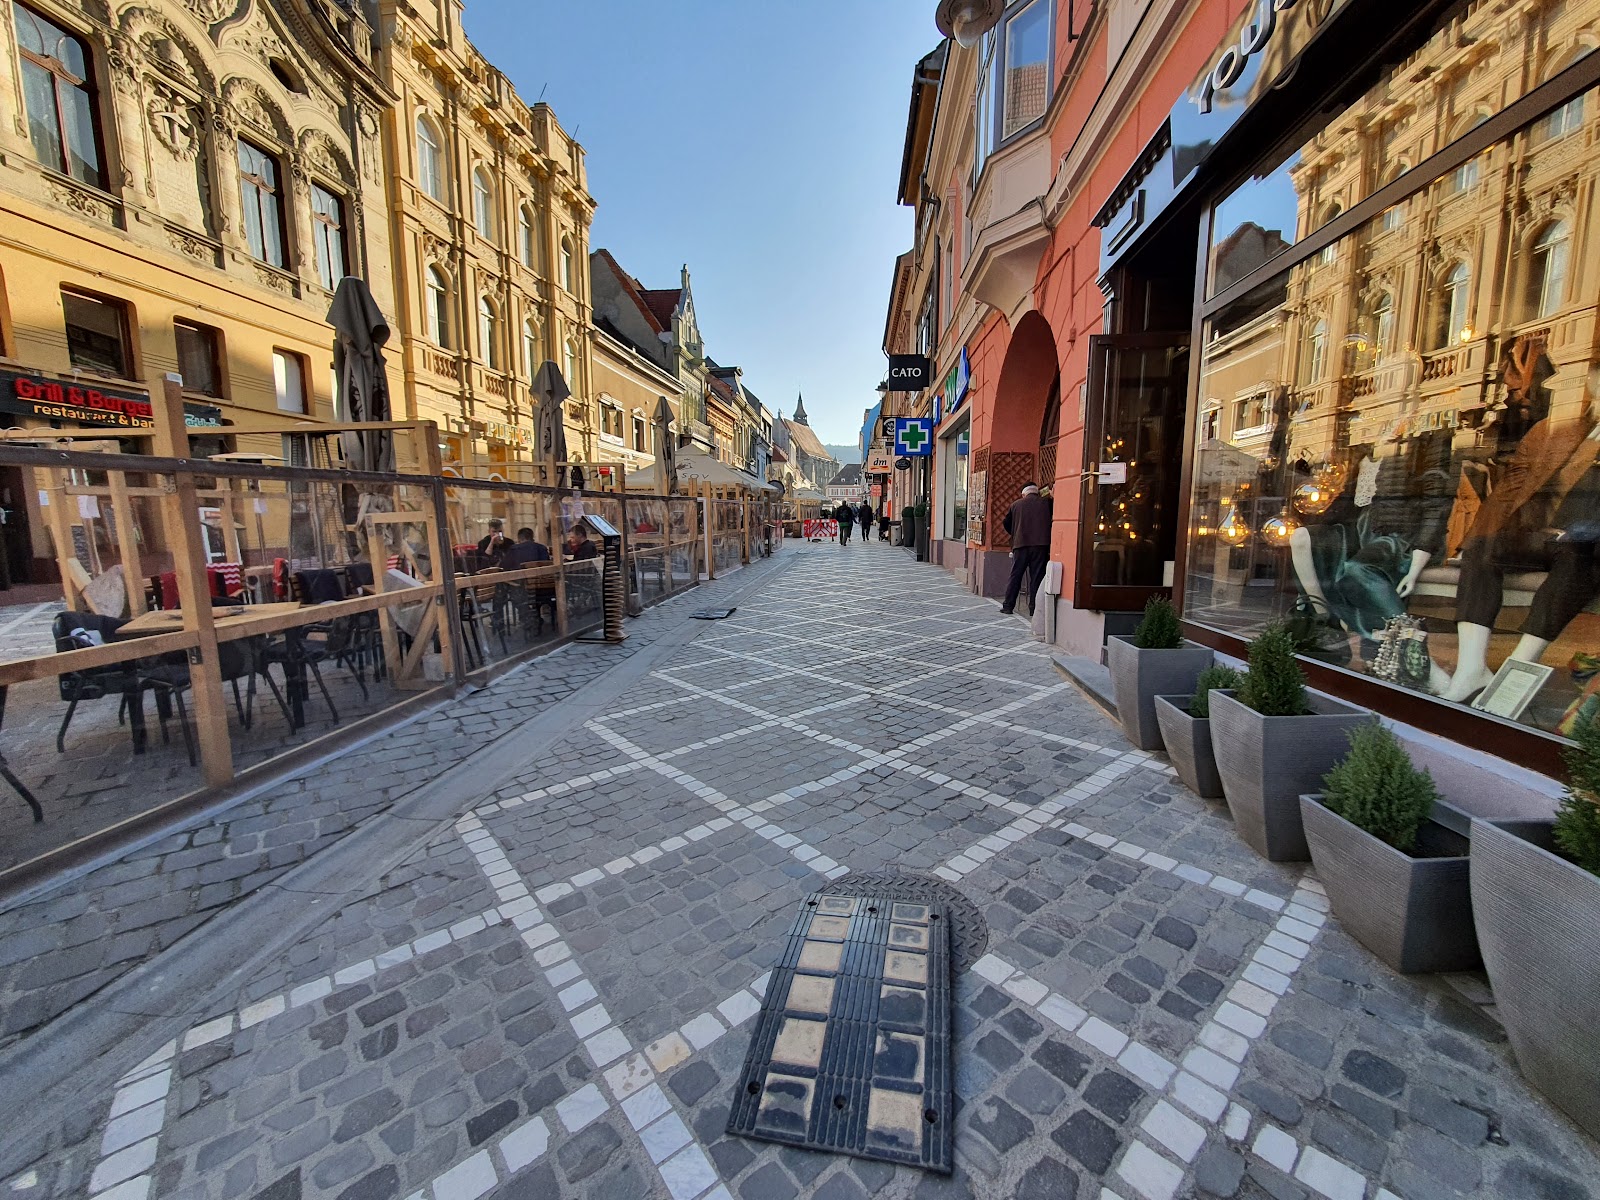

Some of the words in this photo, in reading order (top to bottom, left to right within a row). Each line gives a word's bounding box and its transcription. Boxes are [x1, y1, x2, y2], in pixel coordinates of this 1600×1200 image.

[891, 367, 922, 378] CATO
[15, 377, 64, 403] Grill
[67, 386, 84, 405] &
[118, 414, 129, 426] &
[131, 416, 155, 428] bar
[486, 420, 533, 444] PIETRA
[873, 457, 887, 466] dm
